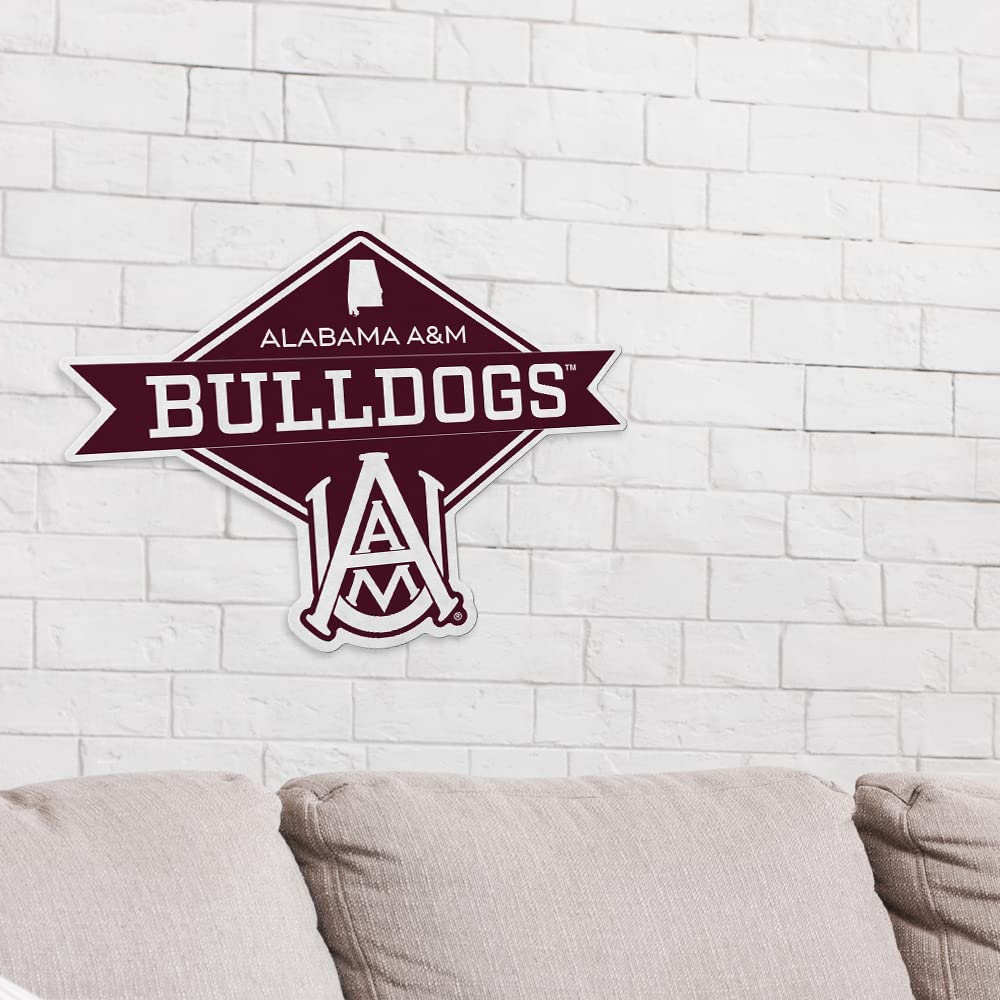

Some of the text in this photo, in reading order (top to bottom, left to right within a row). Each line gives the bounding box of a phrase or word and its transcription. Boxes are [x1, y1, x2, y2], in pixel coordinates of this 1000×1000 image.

[259, 324, 467, 349] ALABAMA A&M
[145, 362, 567, 439] BULLDOGS
